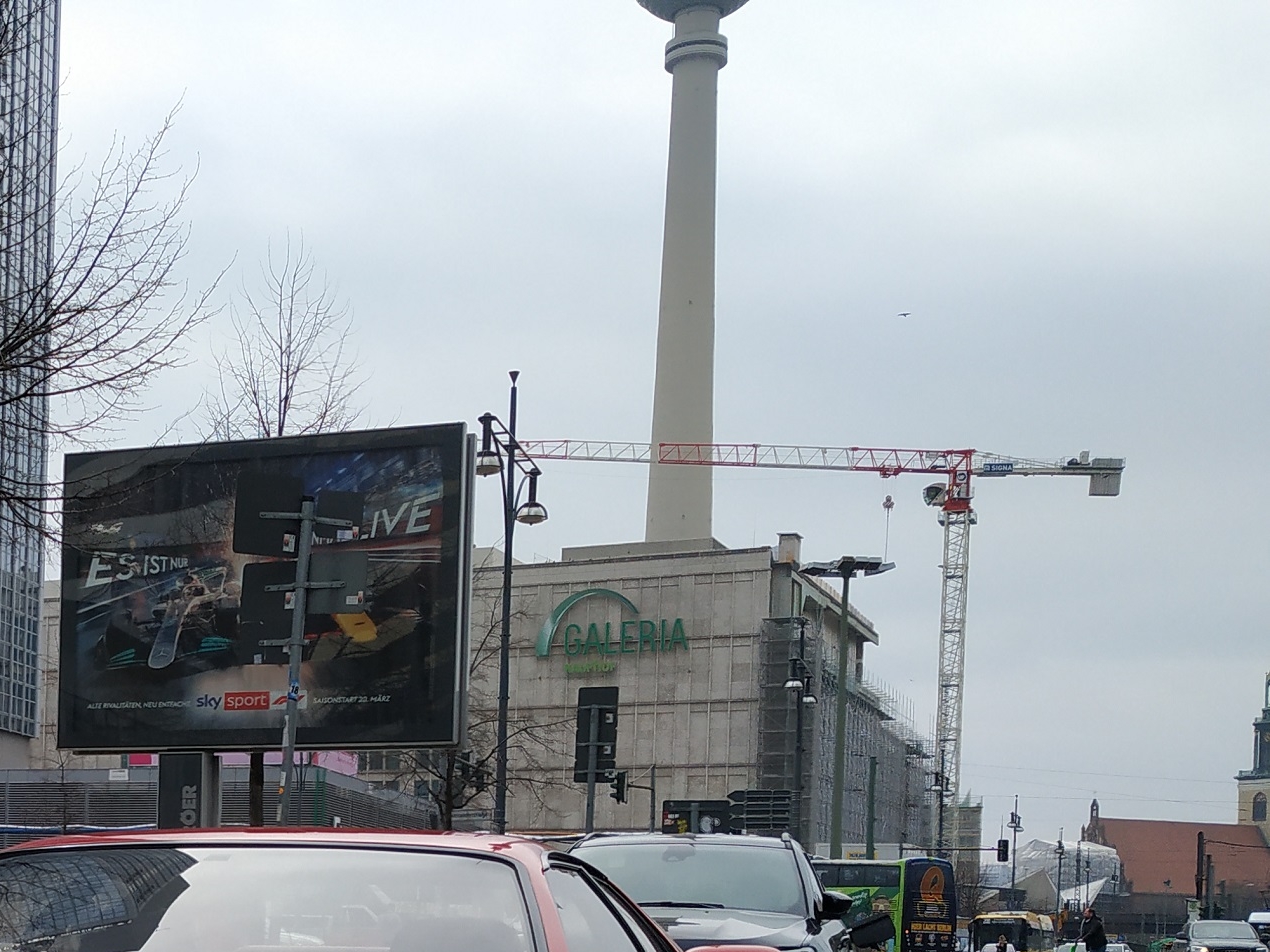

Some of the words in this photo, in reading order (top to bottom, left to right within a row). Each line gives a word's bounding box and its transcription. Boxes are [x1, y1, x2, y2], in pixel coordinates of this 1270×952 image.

[360, 492, 440, 540] IVE
[85, 550, 136, 588] ES
[143, 554, 168, 576] IST
[170, 557, 188, 571] NUR
[564, 618, 689, 657] GALERIA
[196, 694, 223, 710] sky
[227, 694, 267, 709] sport
[290, 685, 300, 695] 18
[370, 694, 391, 703] MÄRZ
[180, 785, 197, 828] ÖER
